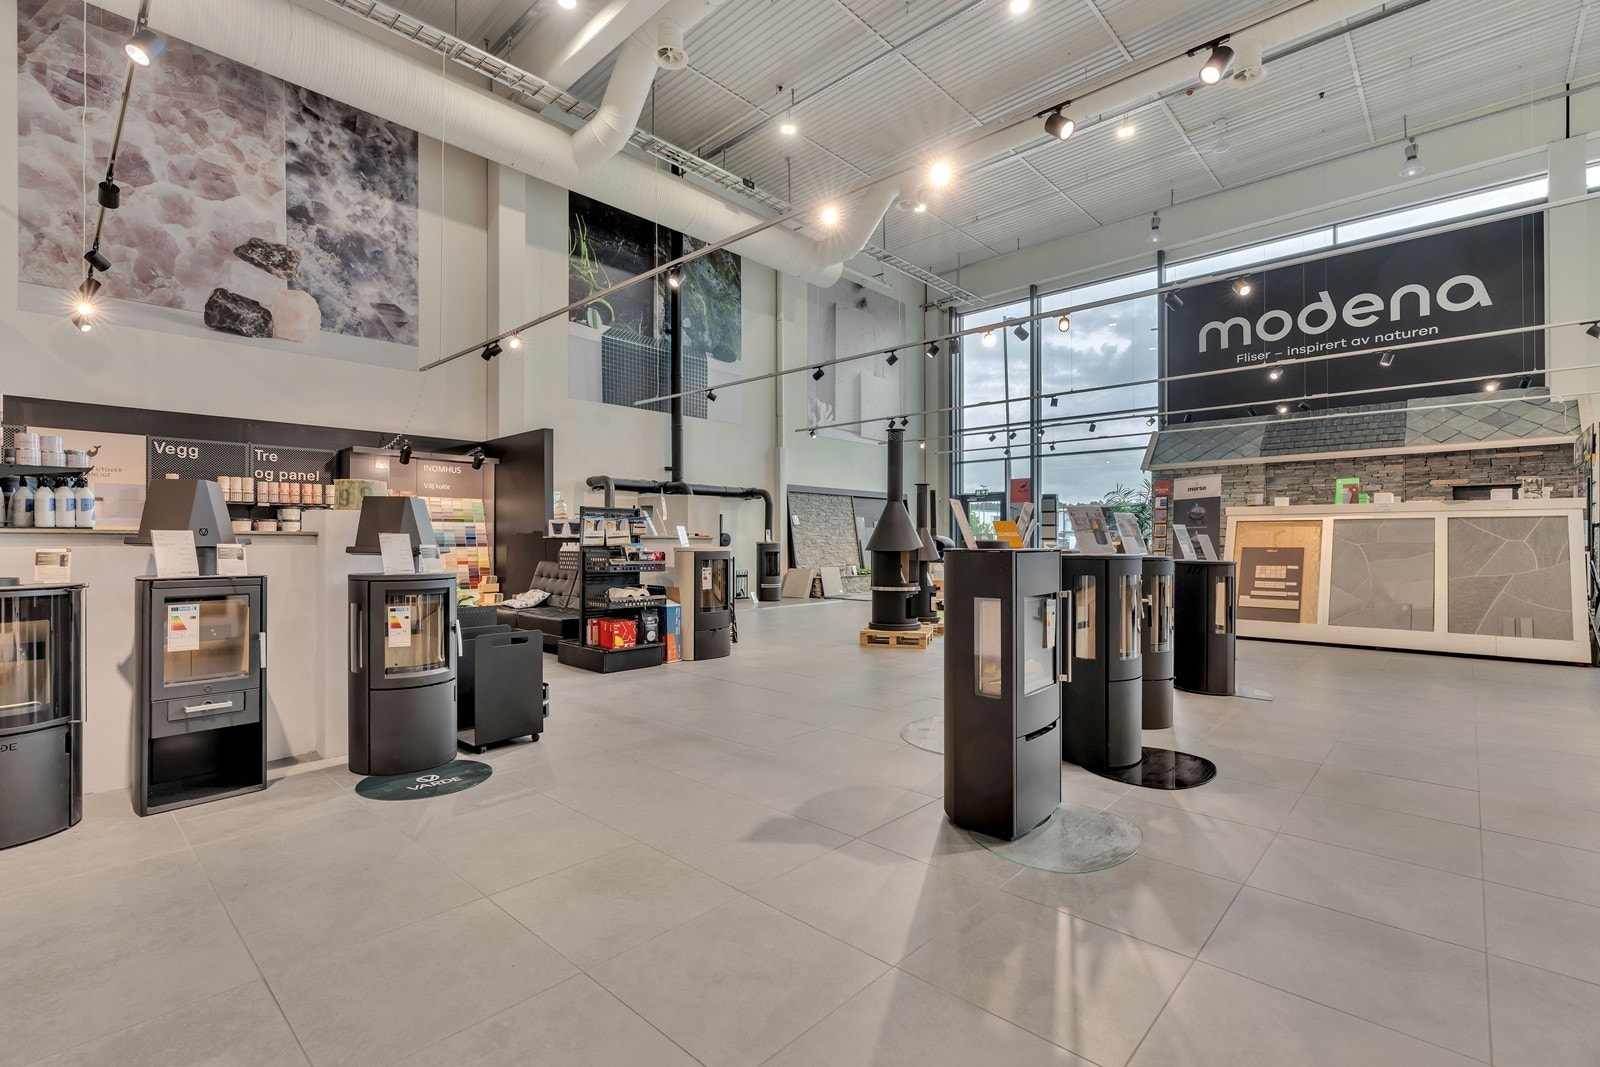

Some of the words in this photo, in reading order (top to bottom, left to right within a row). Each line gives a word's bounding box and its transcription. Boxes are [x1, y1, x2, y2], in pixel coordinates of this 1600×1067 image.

[1198, 274, 1493, 353] modena
[1236, 349, 1271, 363] Fliser
[1286, 338, 1348, 357] inspirert
[1350, 334, 1371, 346] av
[1374, 324, 1439, 343] naturen
[153, 441, 199, 459] Vegg
[254, 449, 278, 462] Tre
[254, 469, 274, 482] og
[278, 470, 320, 482] panel
[423, 464, 462, 474] INOMHUS
[406, 776, 463, 791] VARDE
